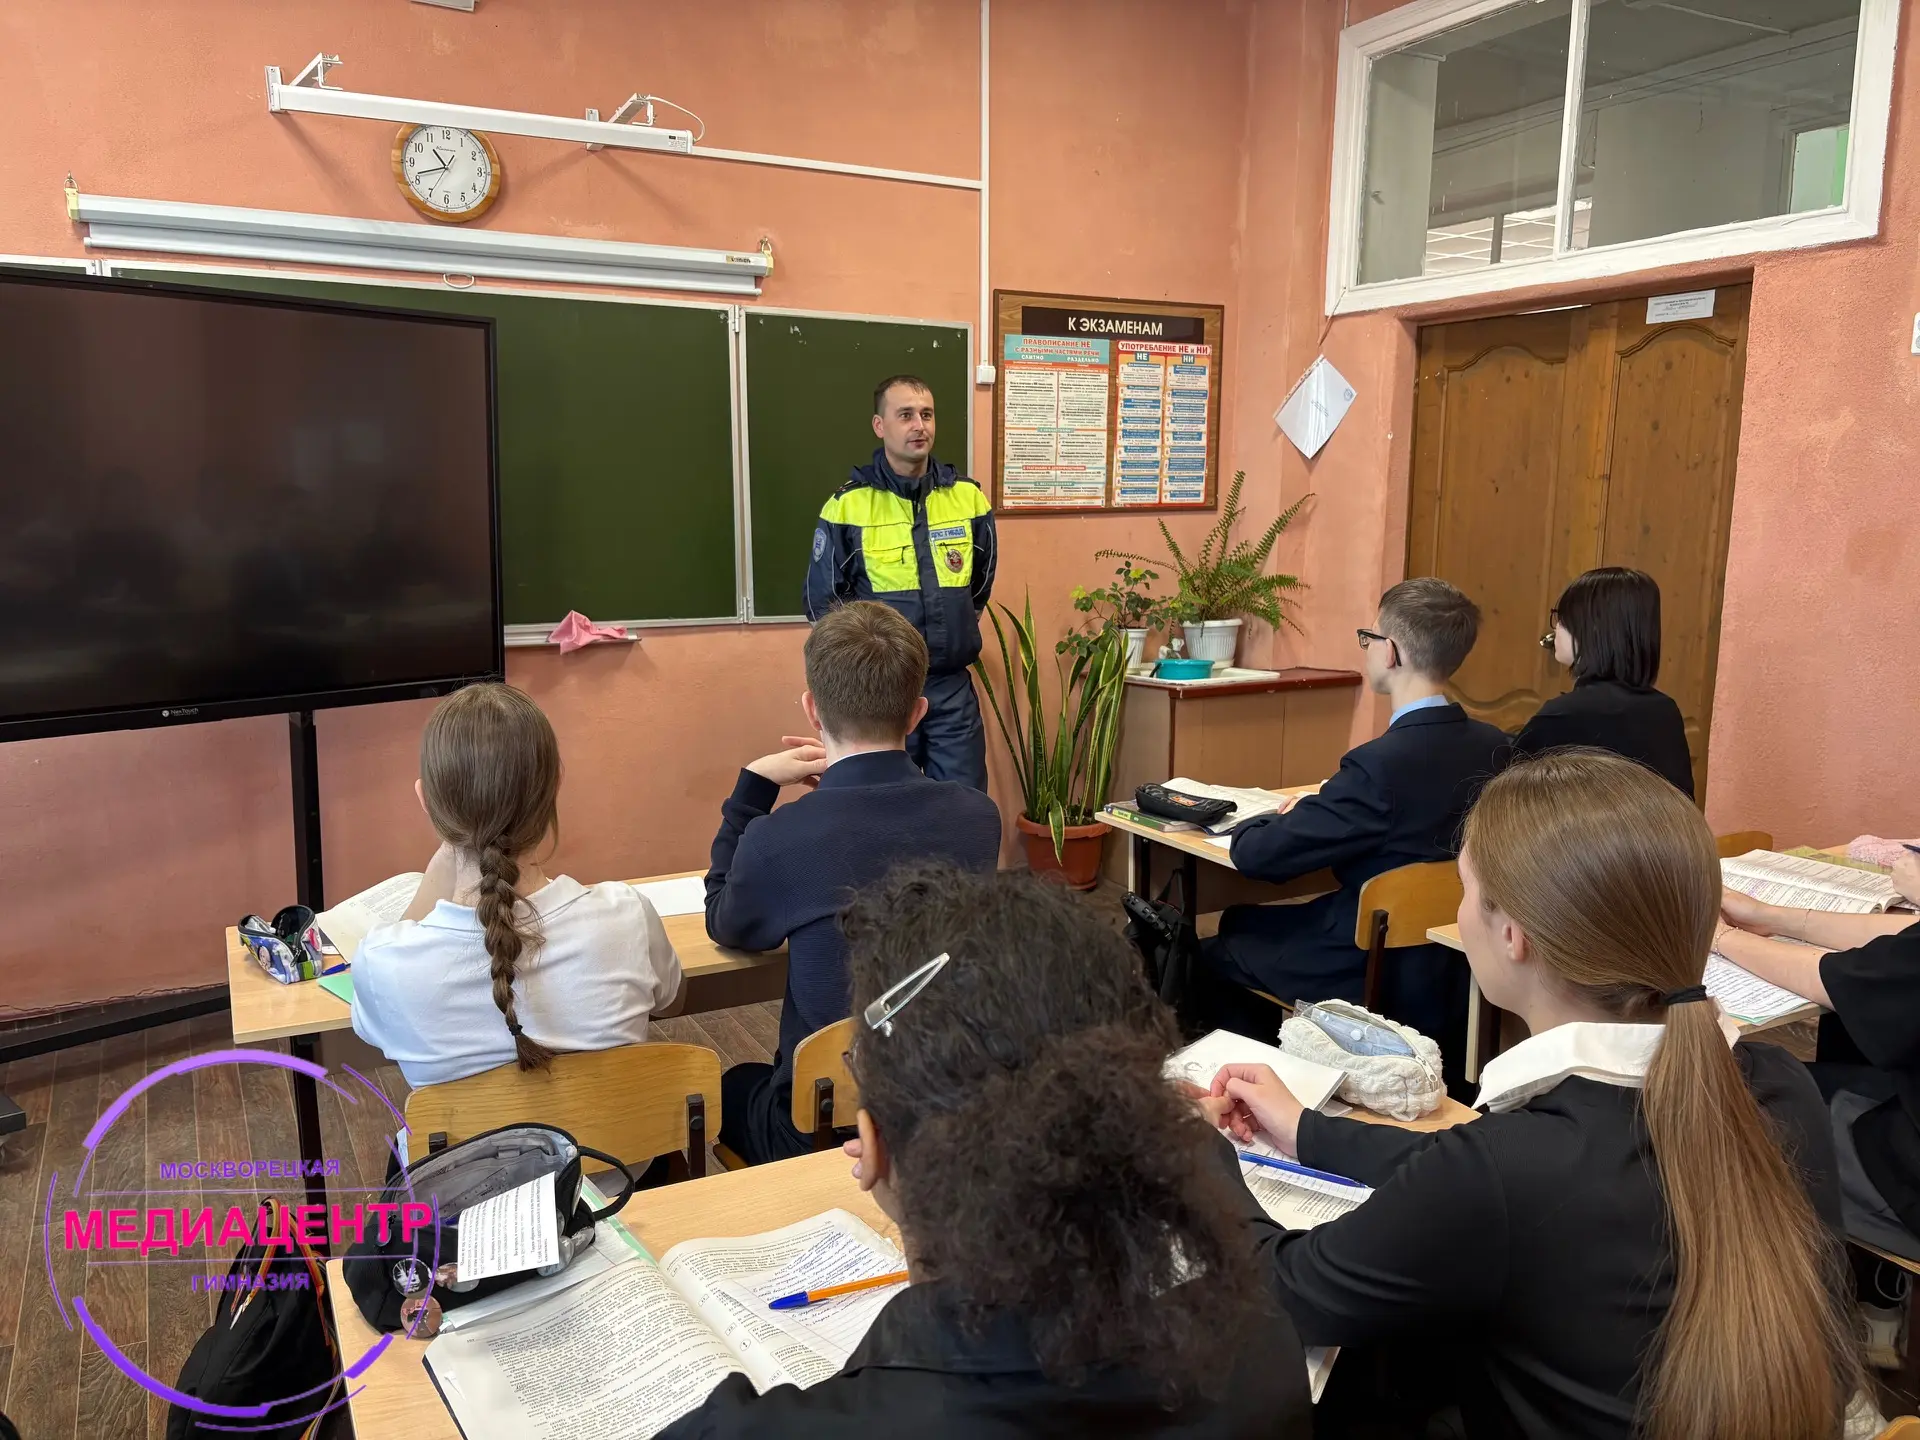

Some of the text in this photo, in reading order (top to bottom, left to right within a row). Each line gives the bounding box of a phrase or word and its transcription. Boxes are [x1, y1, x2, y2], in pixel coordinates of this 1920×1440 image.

[426, 132, 433, 143] 11
[442, 130, 451, 140] 12
[460, 137, 464, 147] 1
[414, 143, 424, 153] 10
[471, 150, 477, 161] 2
[409, 156, 415, 167] 9
[477, 166, 483, 177] 3
[415, 174, 421, 185] 8
[428, 187, 433, 198] 7
[471, 182, 477, 193] 4
[443, 194, 450, 205] 6
[460, 192, 466, 202] 5
[1068, 317, 1163, 336] К ЭКЗАМЕНАМ
[1023, 338, 1091, 348] ПРАВОПИСАНИЕ НЕ
[1120, 342, 1177, 352] УПОТРЕБЛЕНИЕ
[1178, 344, 1189, 353] НЕ
[1196, 346, 1208, 354] НИ
[1136, 352, 1148, 361] НЕ
[1182, 355, 1194, 363] НИ
